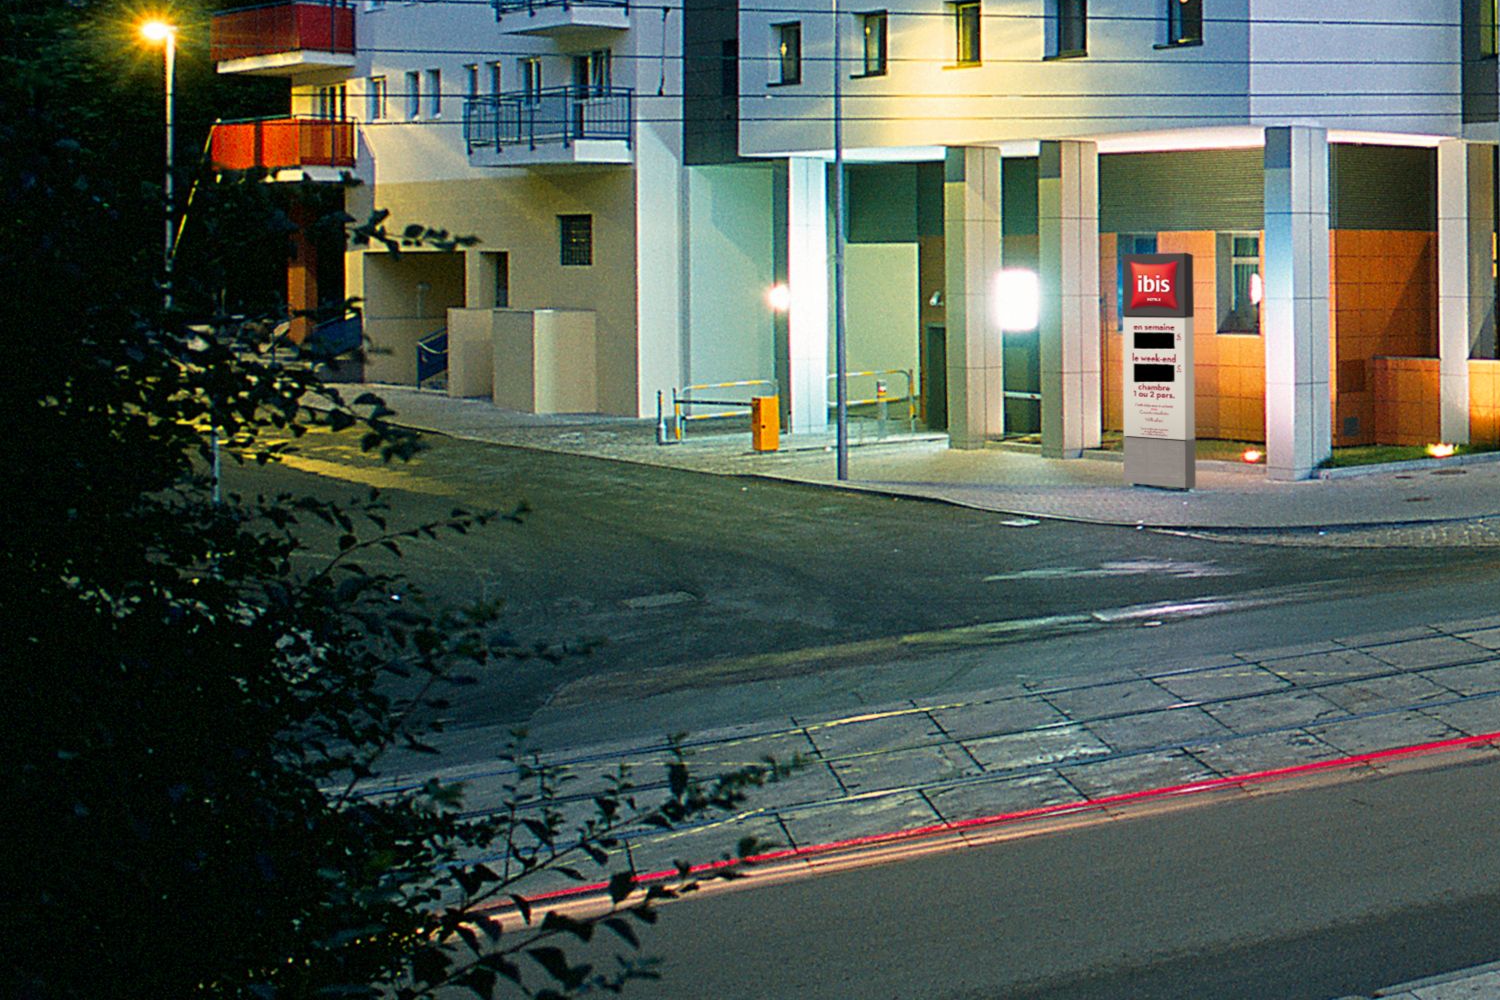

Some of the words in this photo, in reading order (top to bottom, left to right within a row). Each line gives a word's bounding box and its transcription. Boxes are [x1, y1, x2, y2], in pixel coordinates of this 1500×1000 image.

[1137, 274, 1171, 293] ibis
[1144, 323, 1175, 331] semaine
[1132, 352, 1139, 361] le
[1140, 353, 1176, 363] week-end
